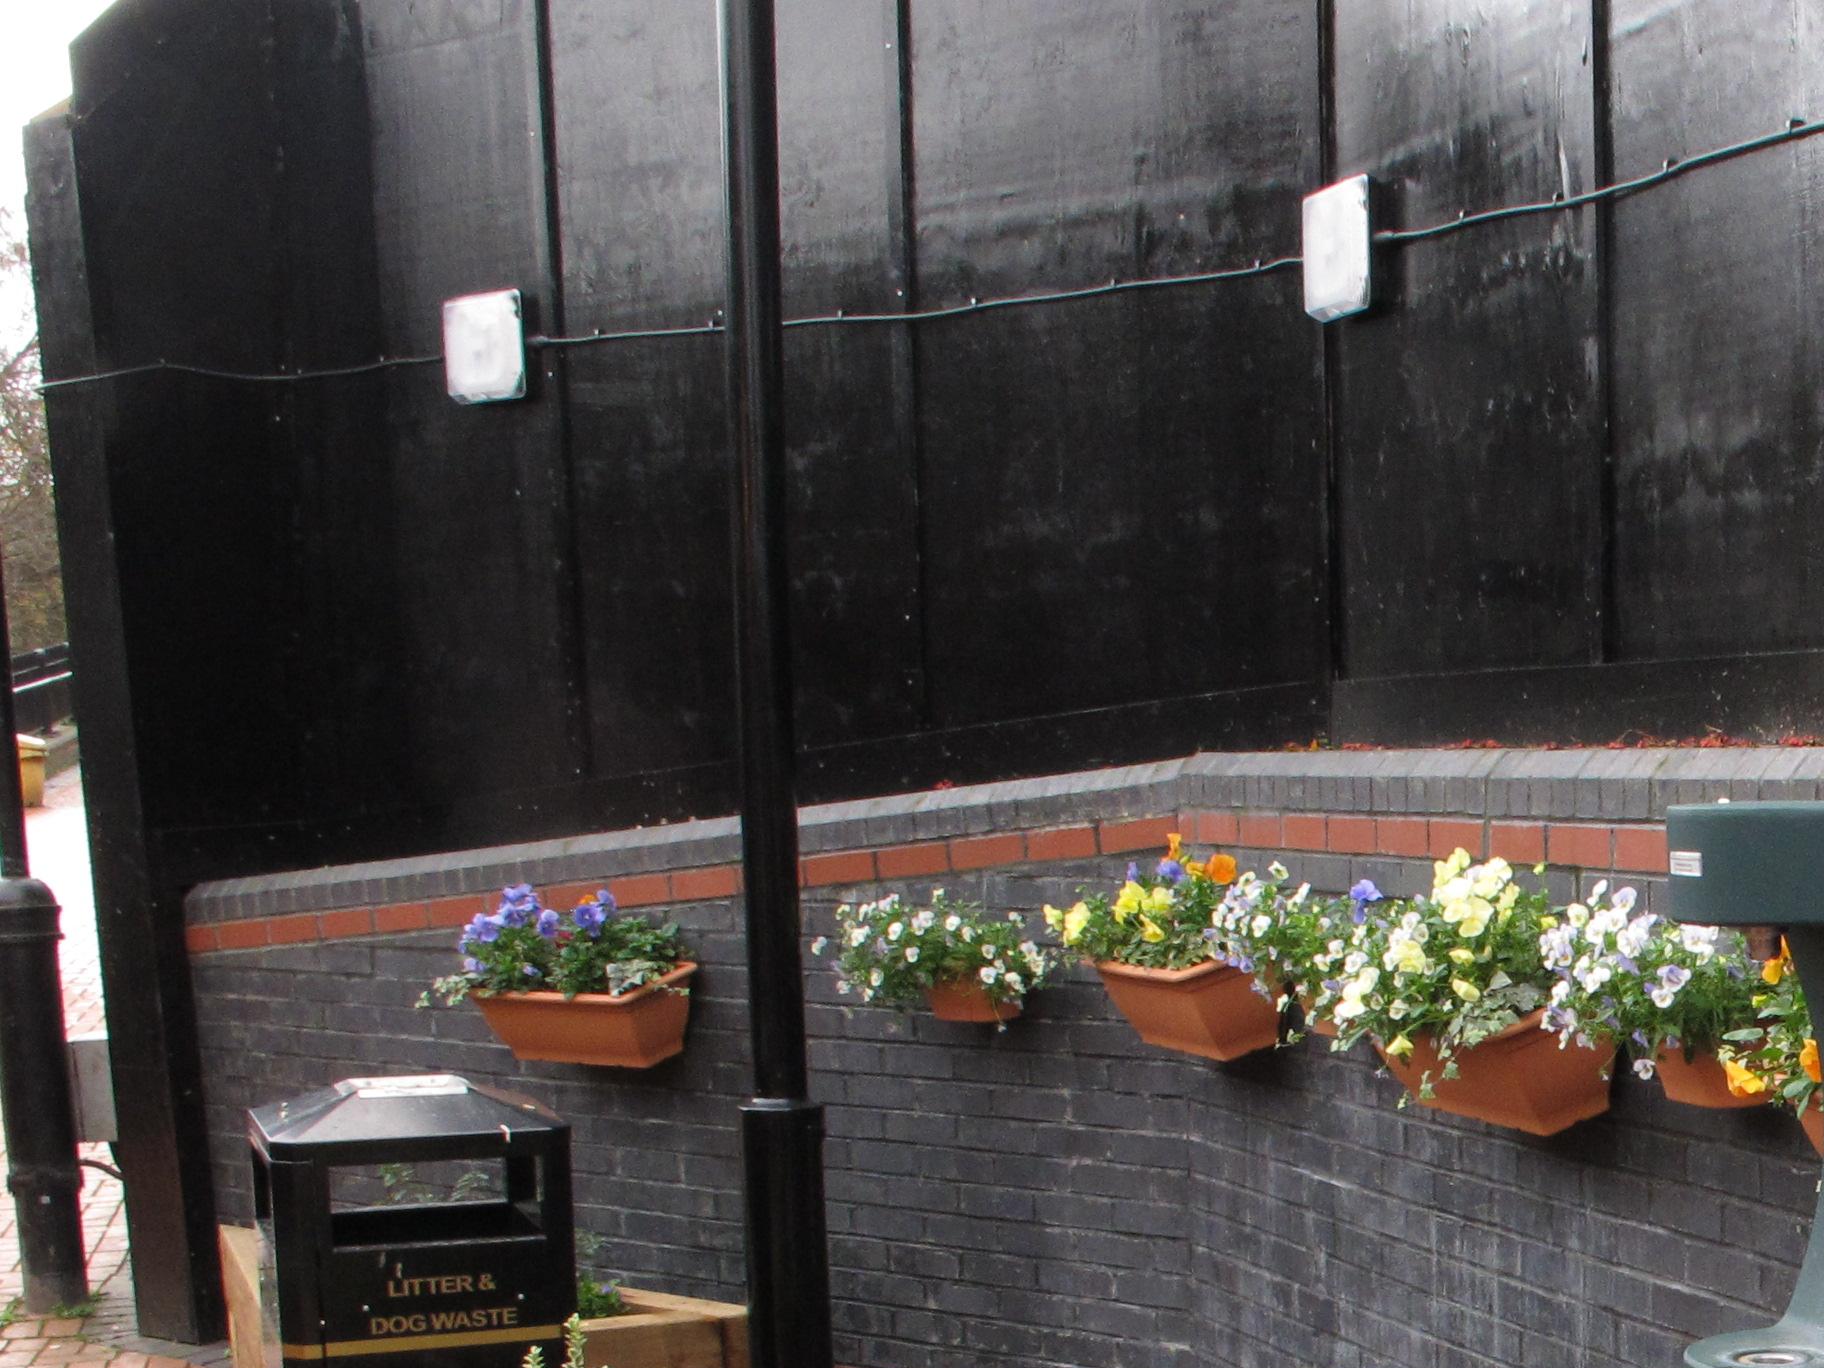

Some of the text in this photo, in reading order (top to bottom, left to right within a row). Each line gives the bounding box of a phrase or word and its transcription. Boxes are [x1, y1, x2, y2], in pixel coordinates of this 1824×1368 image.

[386, 1272, 497, 1298] LITTER &
[371, 1307, 519, 1336] DOG WASTE
